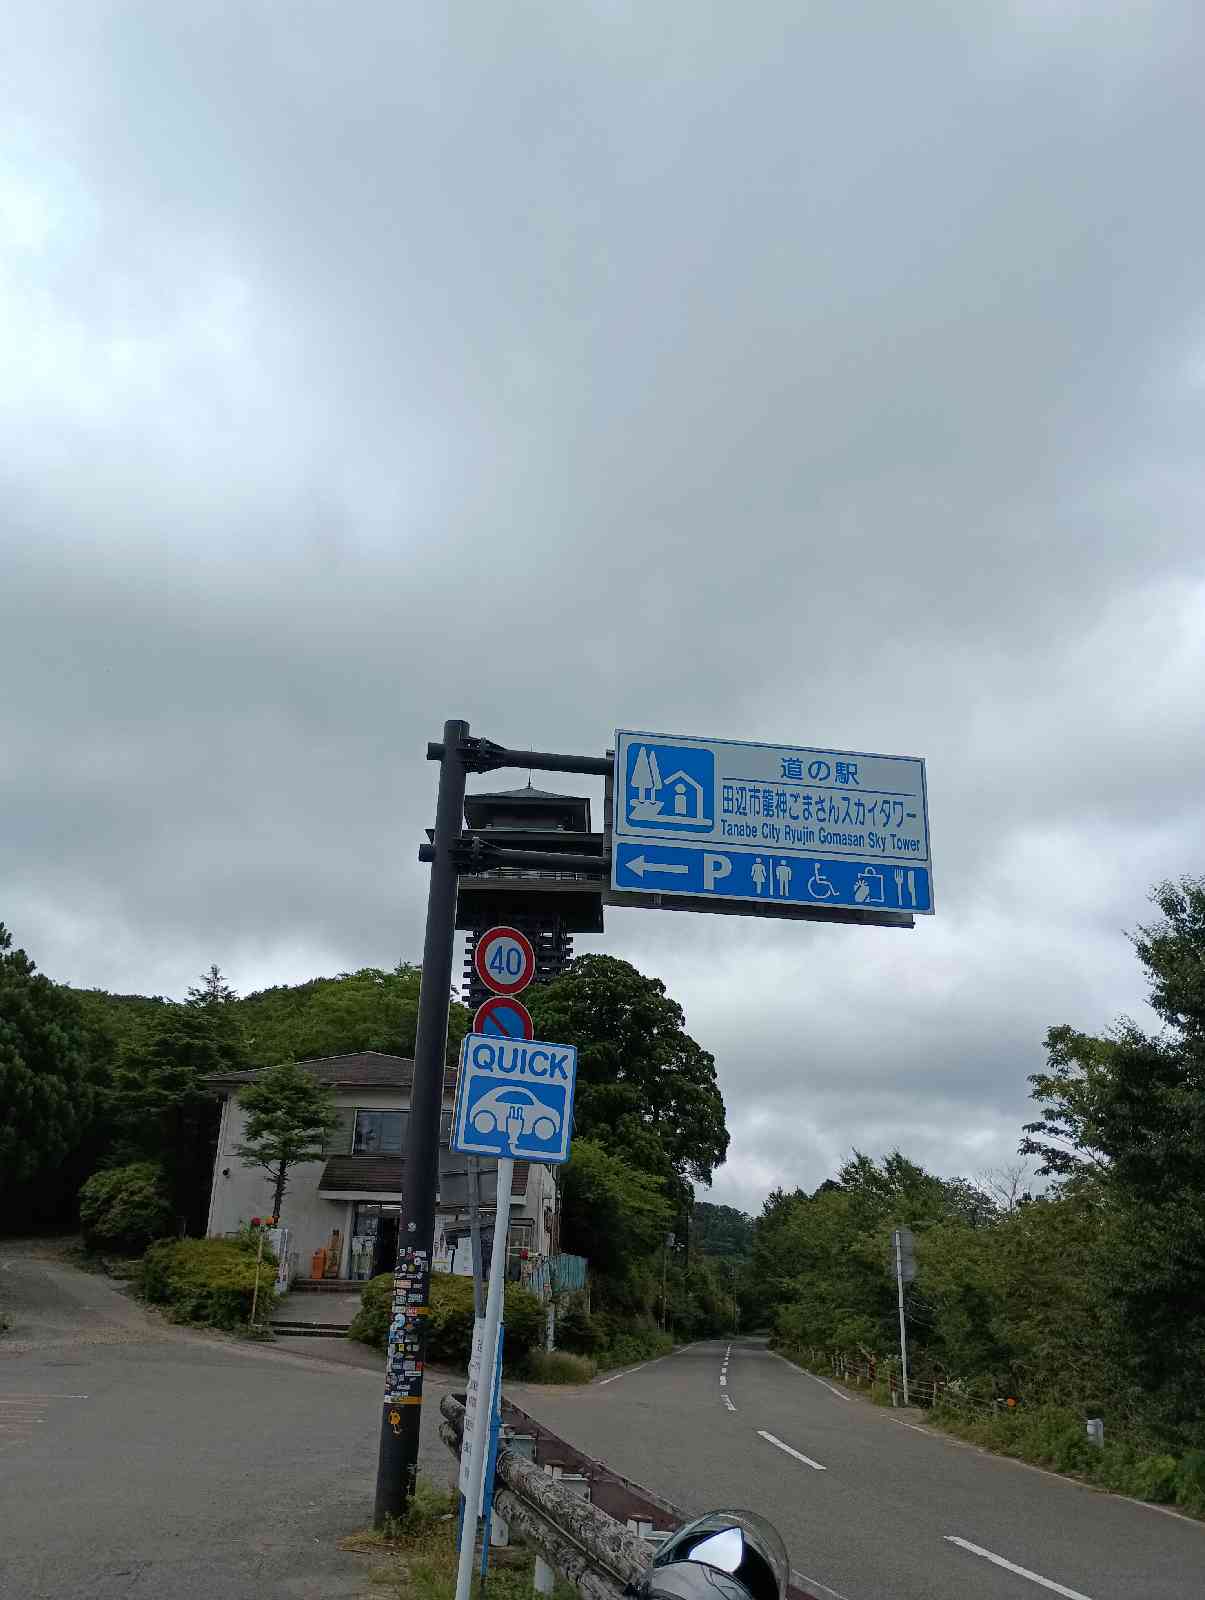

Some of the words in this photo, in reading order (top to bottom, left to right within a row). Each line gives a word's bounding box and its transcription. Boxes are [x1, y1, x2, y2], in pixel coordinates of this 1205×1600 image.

[780, 757, 860, 785] 道の駅
[721, 785, 917, 828] 田辺市龍神ごまさんスカイタワー
[721, 819, 757, 838] Tanabe
[761, 822, 781, 843] City
[784, 824, 815, 845] Ryujin
[818, 827, 865, 848] Gomasan
[868, 831, 887, 852] Sky
[890, 833, 920, 851] Tower
[703, 853, 732, 890] P
[489, 945, 522, 976] 40
[472, 1043, 569, 1081] QUICK
